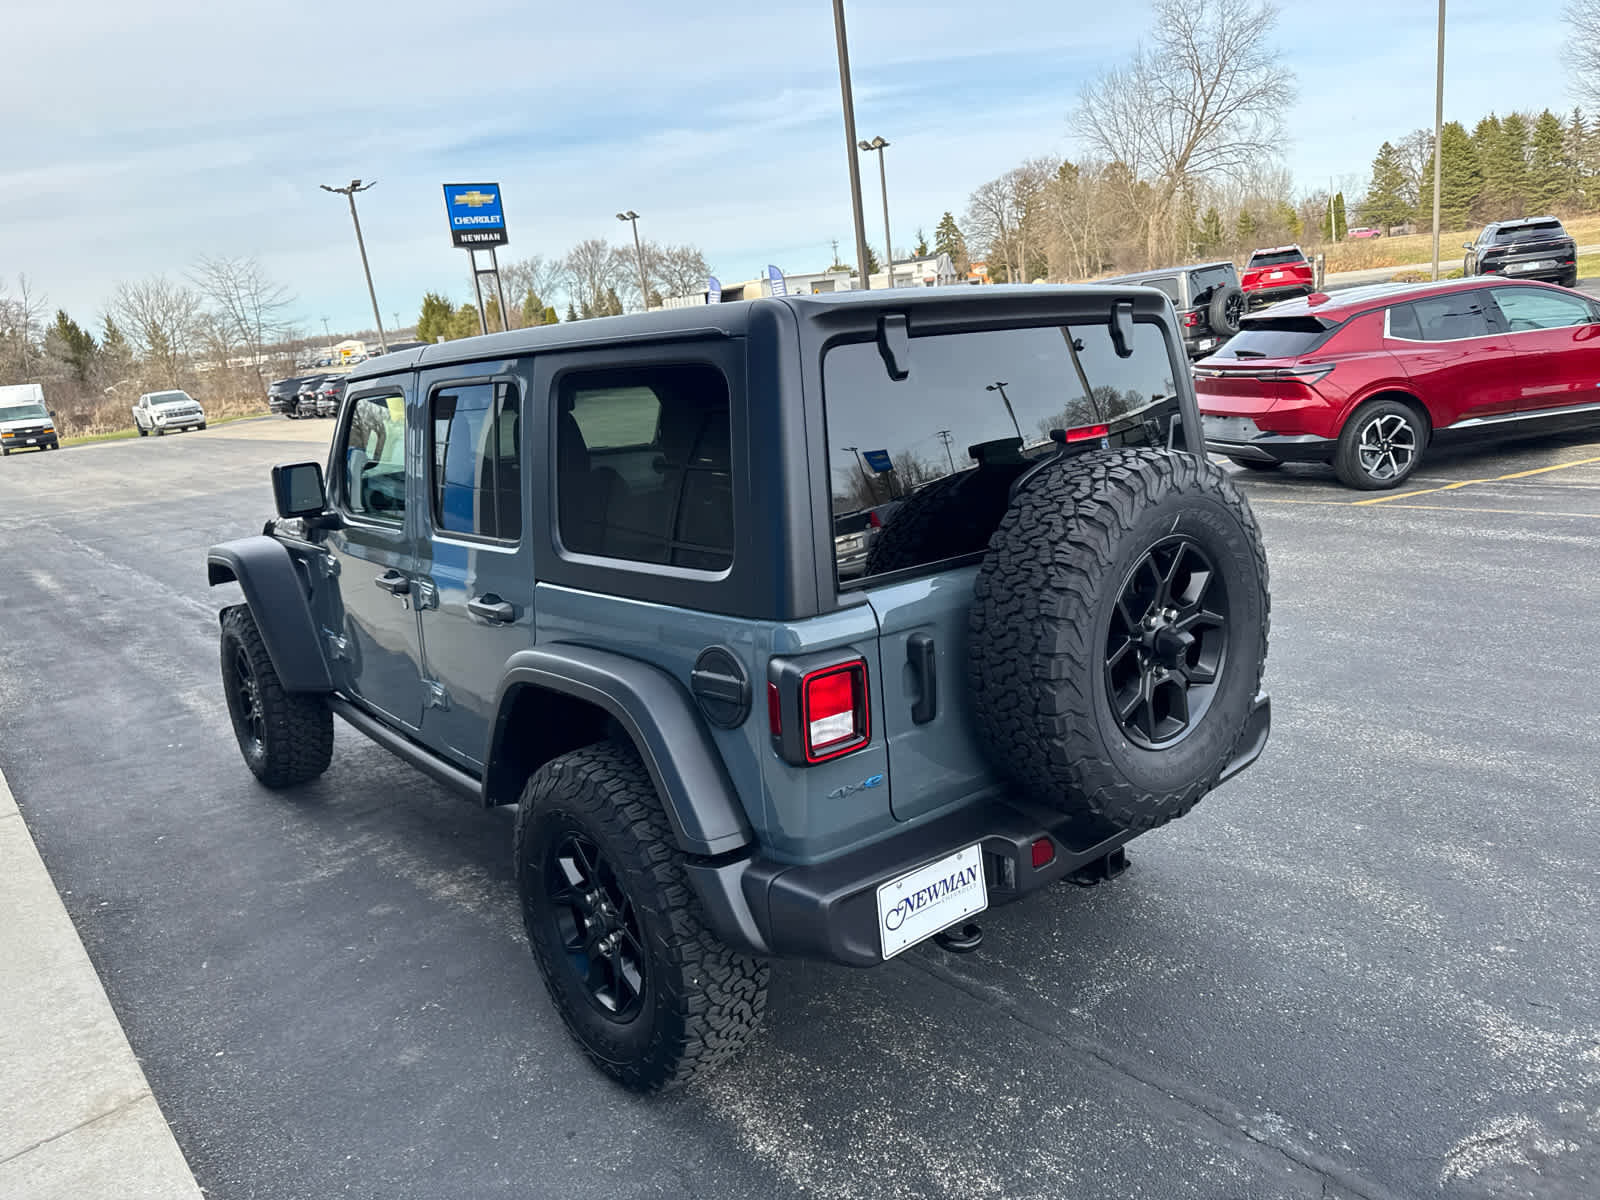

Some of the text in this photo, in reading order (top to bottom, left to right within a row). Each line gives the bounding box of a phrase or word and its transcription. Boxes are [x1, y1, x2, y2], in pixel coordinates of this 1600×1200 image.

[454, 215, 501, 225] CHEVROLET
[461, 232, 501, 242] NEWMAN
[885, 864, 978, 931] NEWMAN
